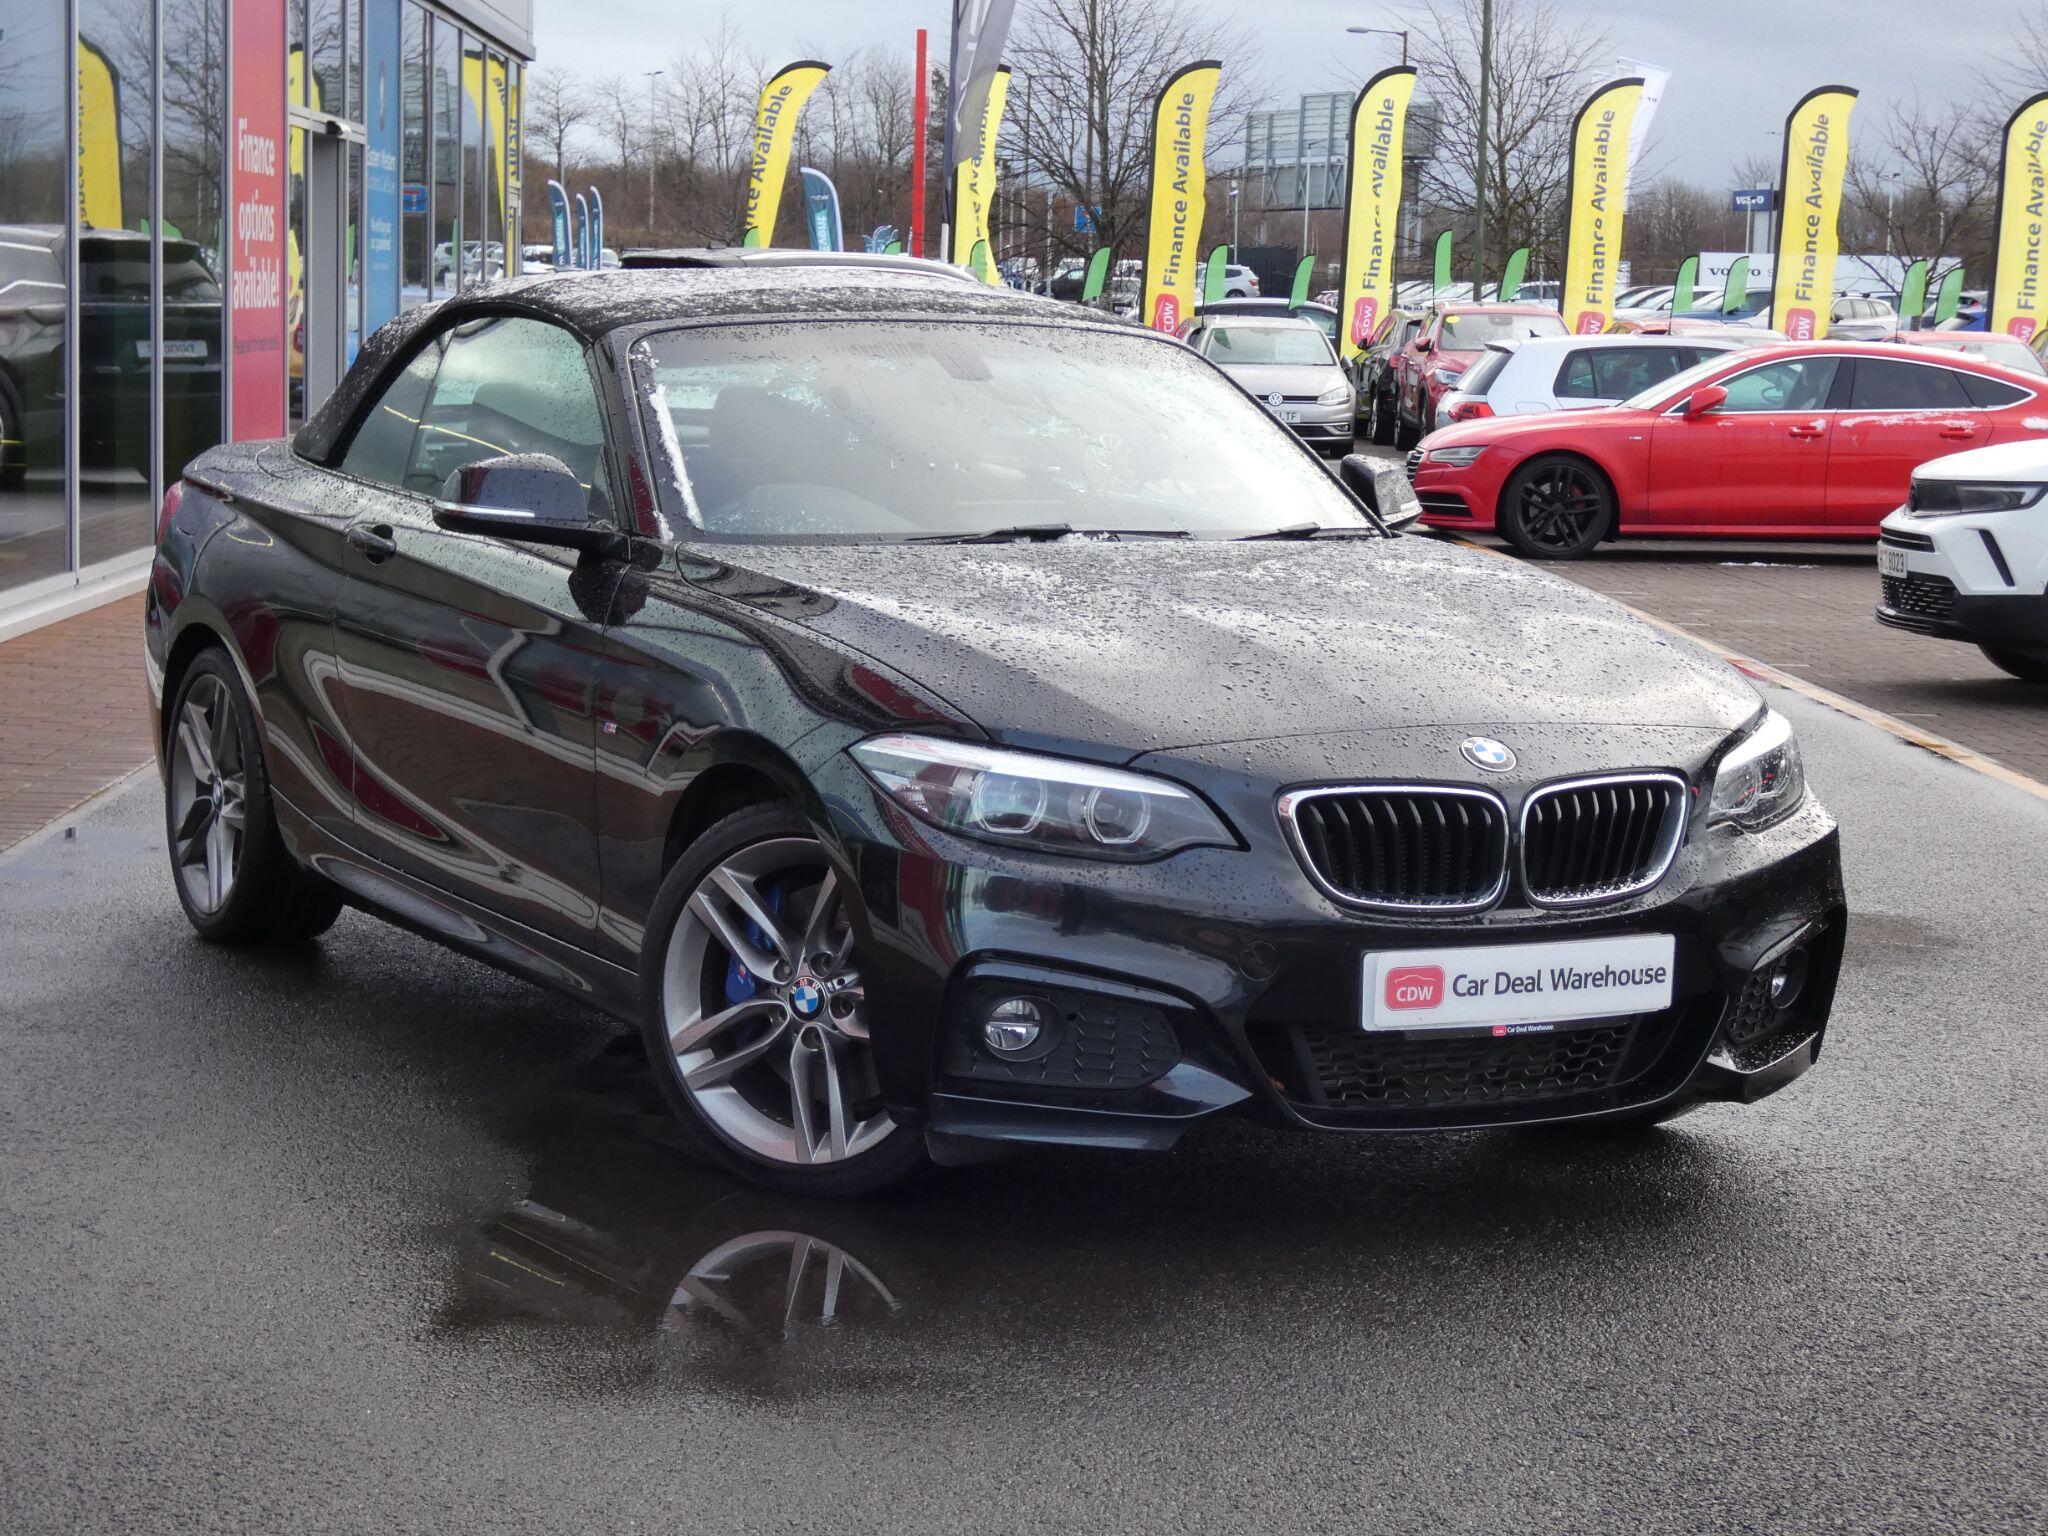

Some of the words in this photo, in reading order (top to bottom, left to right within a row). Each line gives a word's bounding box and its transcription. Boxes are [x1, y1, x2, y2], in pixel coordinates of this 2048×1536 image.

[238, 117, 276, 177] Finance
[750, 84, 793, 183] Available
[1172, 92, 1195, 194] Available
[1371, 98, 1395, 198] Available
[1590, 109, 1615, 213] Available
[1805, 113, 1830, 210] Available
[238, 189, 276, 256] options
[1162, 199, 1188, 287] Finance
[1362, 204, 1383, 290] Finance
[1586, 216, 1606, 305] Finance
[1795, 213, 1821, 301] Finance
[2016, 222, 2042, 310] Finance
[233, 257, 280, 309] available!
[1709, 267, 1762, 277] VOO
[1163, 301, 1175, 333] CDW
[1361, 304, 1373, 336] CDW
[1797, 316, 1811, 340] DW
[1396, 985, 1434, 1003] CDW
[1452, 973, 1489, 997] Car
[1494, 969, 1543, 995] Deal
[1550, 964, 1667, 992] Warehouse
